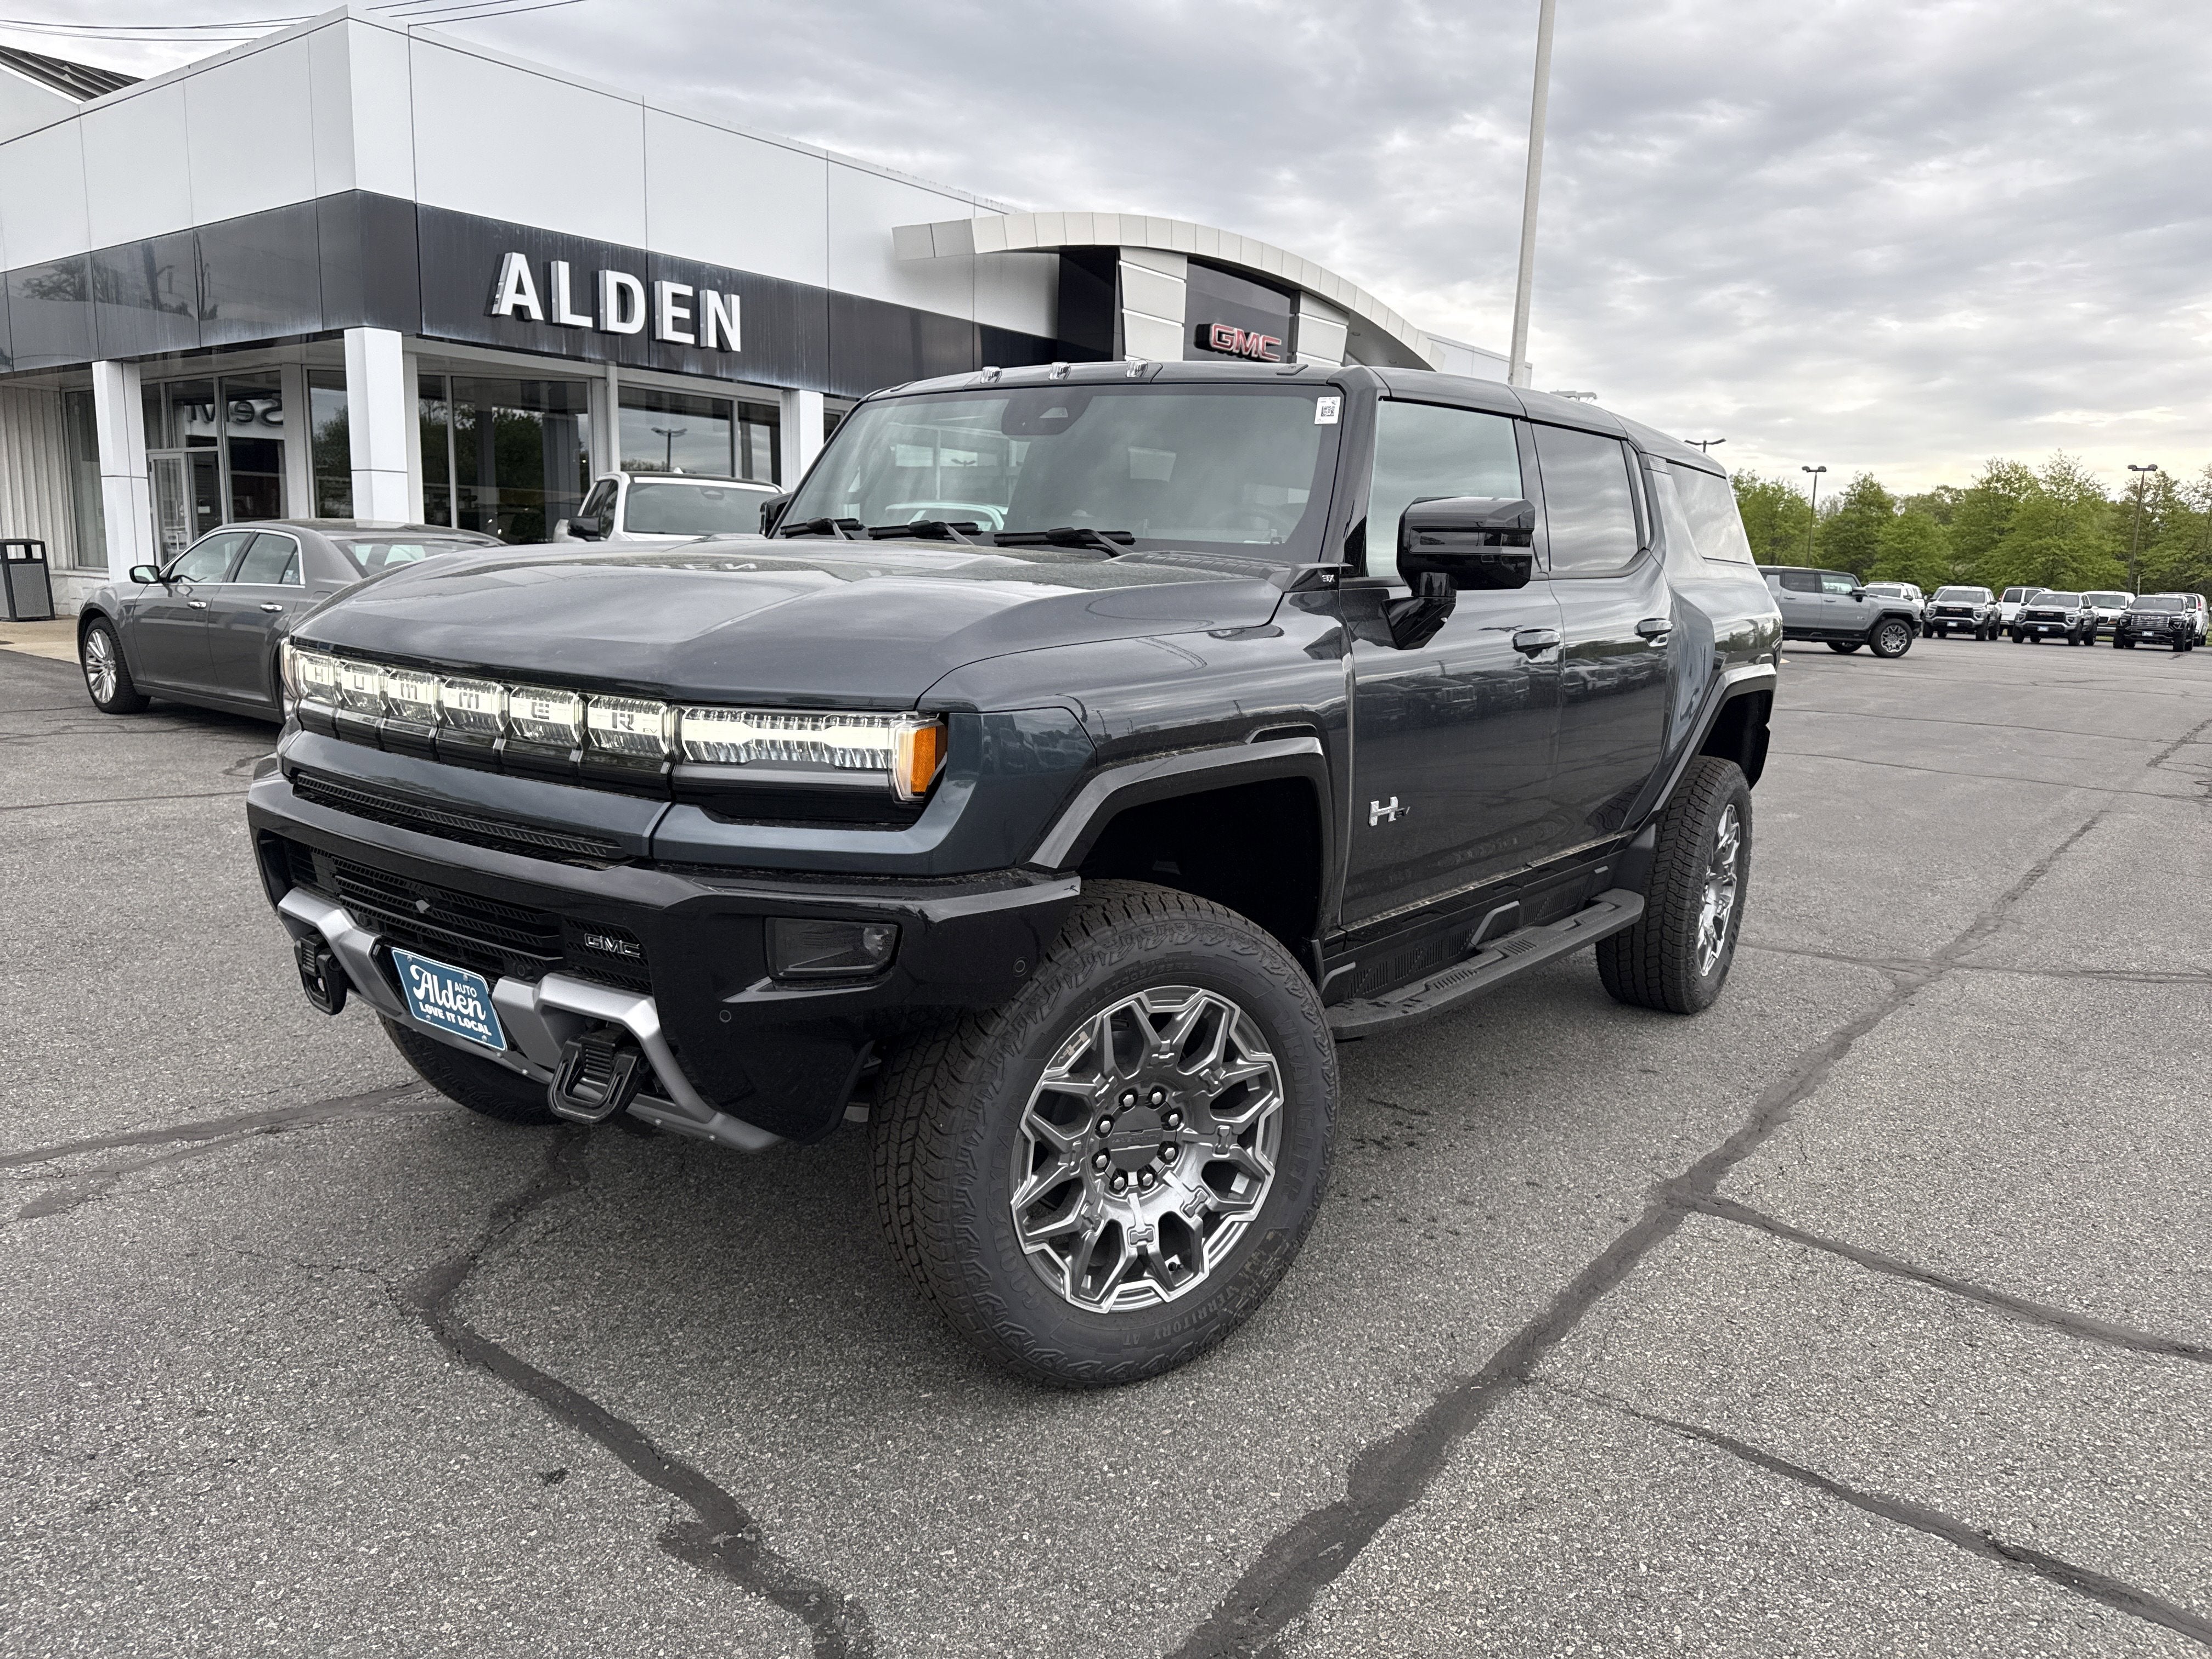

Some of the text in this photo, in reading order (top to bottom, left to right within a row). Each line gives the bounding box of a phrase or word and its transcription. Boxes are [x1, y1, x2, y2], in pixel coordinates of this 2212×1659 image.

[492, 252, 741, 352] ALDEN
[1211, 323, 1282, 362] GMC
[314, 666, 634, 731] HUMMER
[584, 933, 640, 958] GMC
[410, 964, 486, 1020] Alden
[454, 982, 477, 998] AUTO
[419, 1002, 492, 1036] LOVE IT LOCAL
[1272, 1009, 1316, 1201] WRANGLER
[1123, 1285, 1240, 1345] TERRITORY AT
